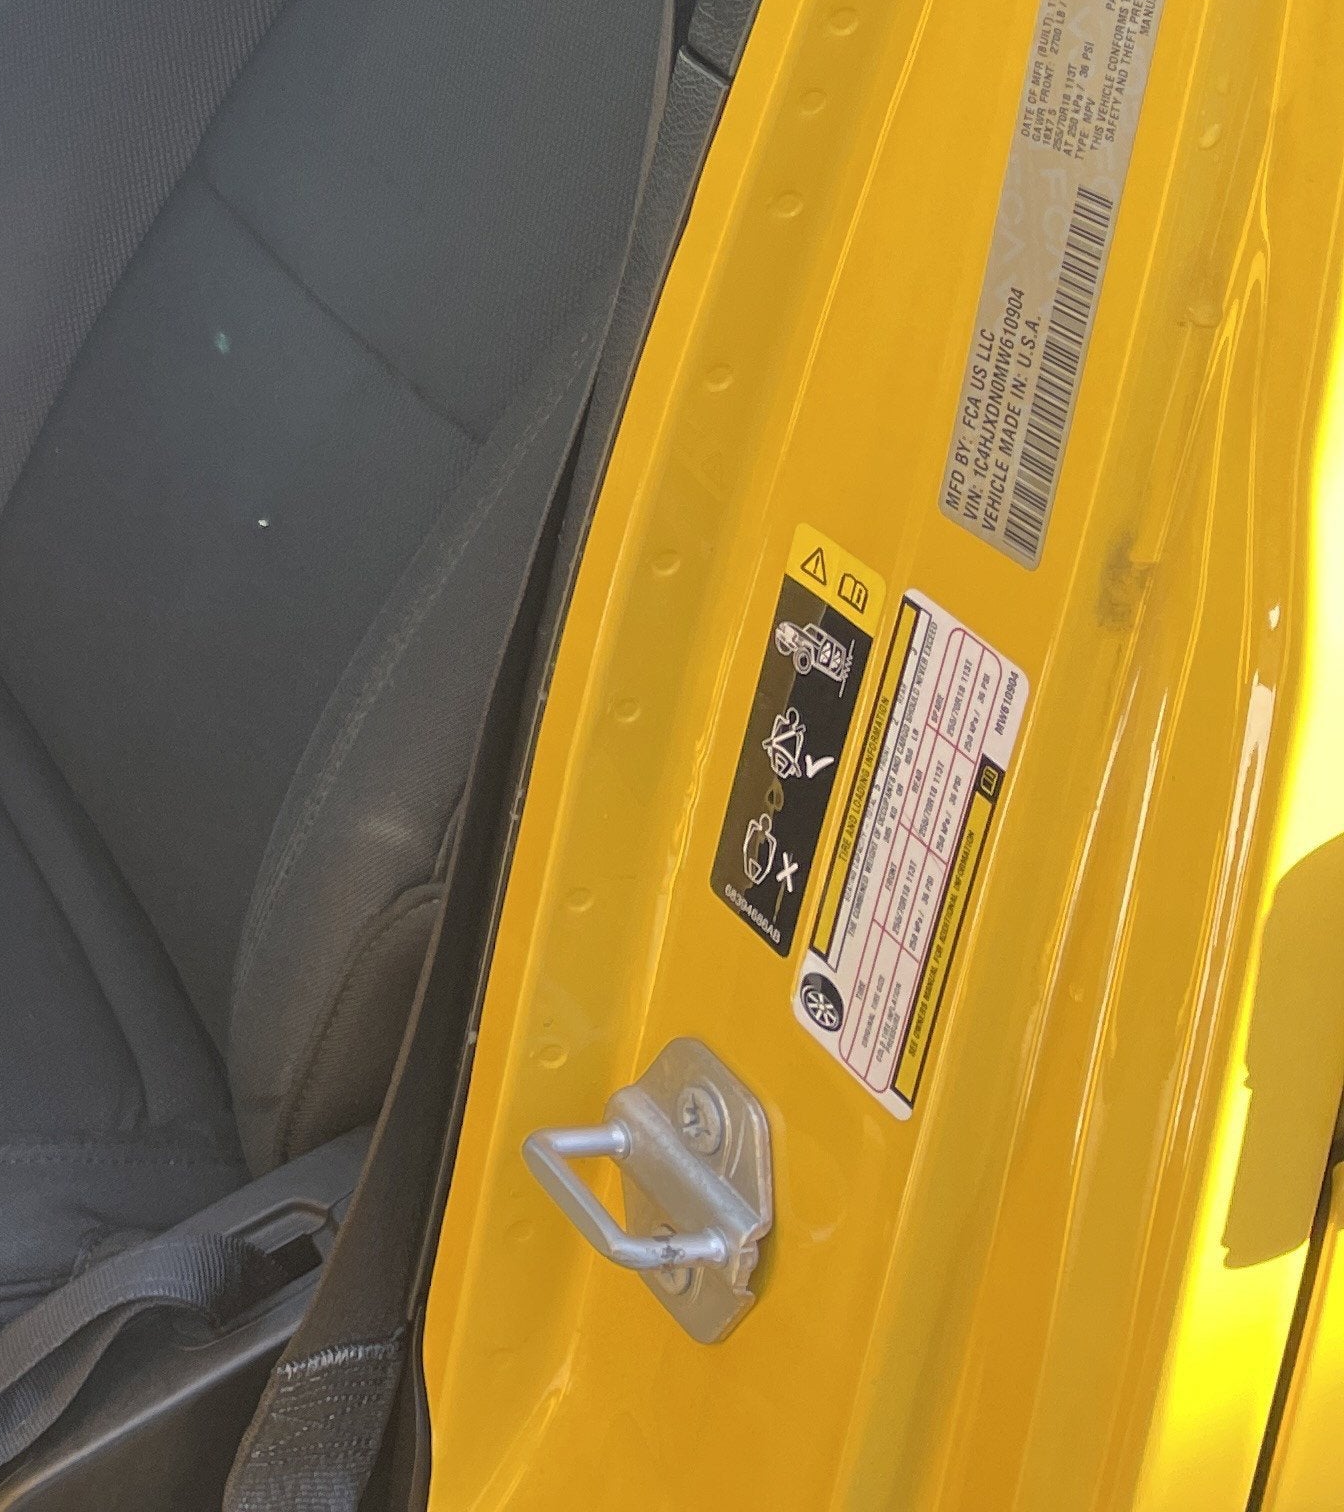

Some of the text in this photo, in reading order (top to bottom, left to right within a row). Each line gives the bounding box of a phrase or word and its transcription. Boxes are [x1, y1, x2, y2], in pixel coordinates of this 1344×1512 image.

[1054, 8, 1066, 26] LB
[1048, 25, 1063, 55] 2700
[1105, 4, 1129, 73] CONFORMS
[1118, 25, 1138, 67] THEFT
[1030, 58, 1044, 87] MFR
[1112, 66, 1129, 96] AND
[1026, 87, 1039, 105] OF
[1094, 72, 1115, 124] VEHICLE
[1020, 105, 1035, 138] DATE
[1030, 105, 1046, 143] GAWR
[1088, 122, 1104, 154] THIS
[1102, 94, 1123, 143] SAFETY
[945, 326, 995, 512] MFD BY: FCA US LLC
[962, 284, 1025, 524] VIN: 1C4HJXDN0MW610904
[981, 308, 1041, 536] VEHICLE MADE IN: U.S.A.
[993, 668, 1020, 737] MW610904
[837, 693, 890, 864] TIRE AND LOADING INFORMATION
